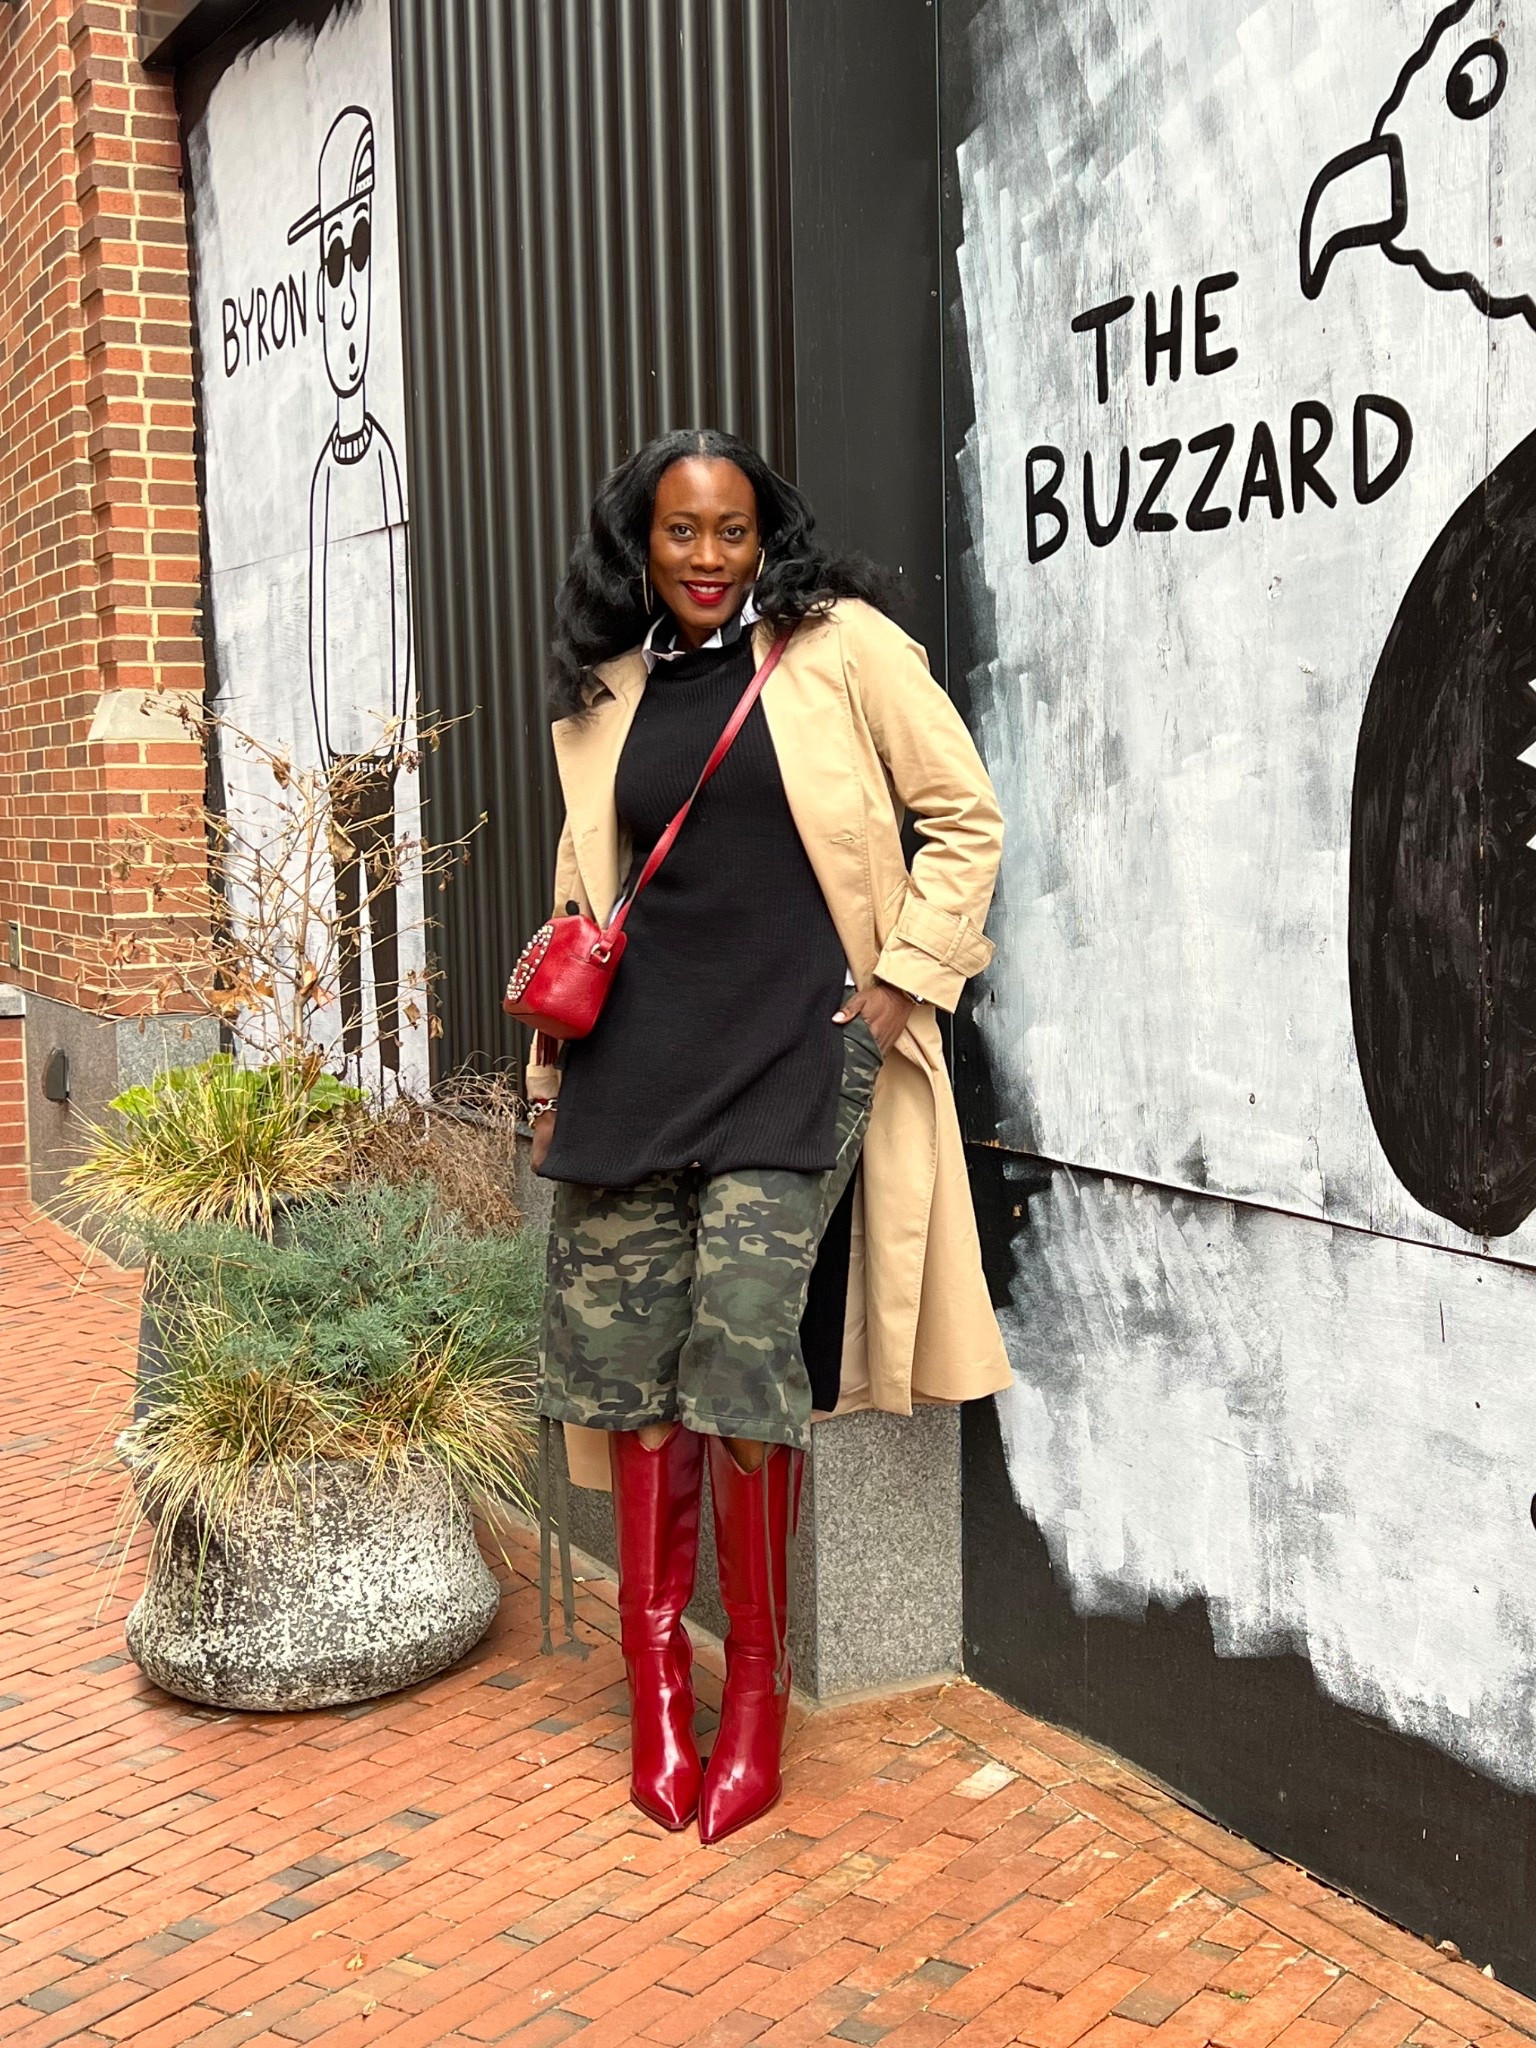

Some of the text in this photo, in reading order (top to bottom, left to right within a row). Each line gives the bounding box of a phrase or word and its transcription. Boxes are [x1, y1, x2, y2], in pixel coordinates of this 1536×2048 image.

[222, 270, 307, 378] BYRON
[1070, 271, 1239, 405] THE
[1025, 394, 1413, 565] BUZZARD
